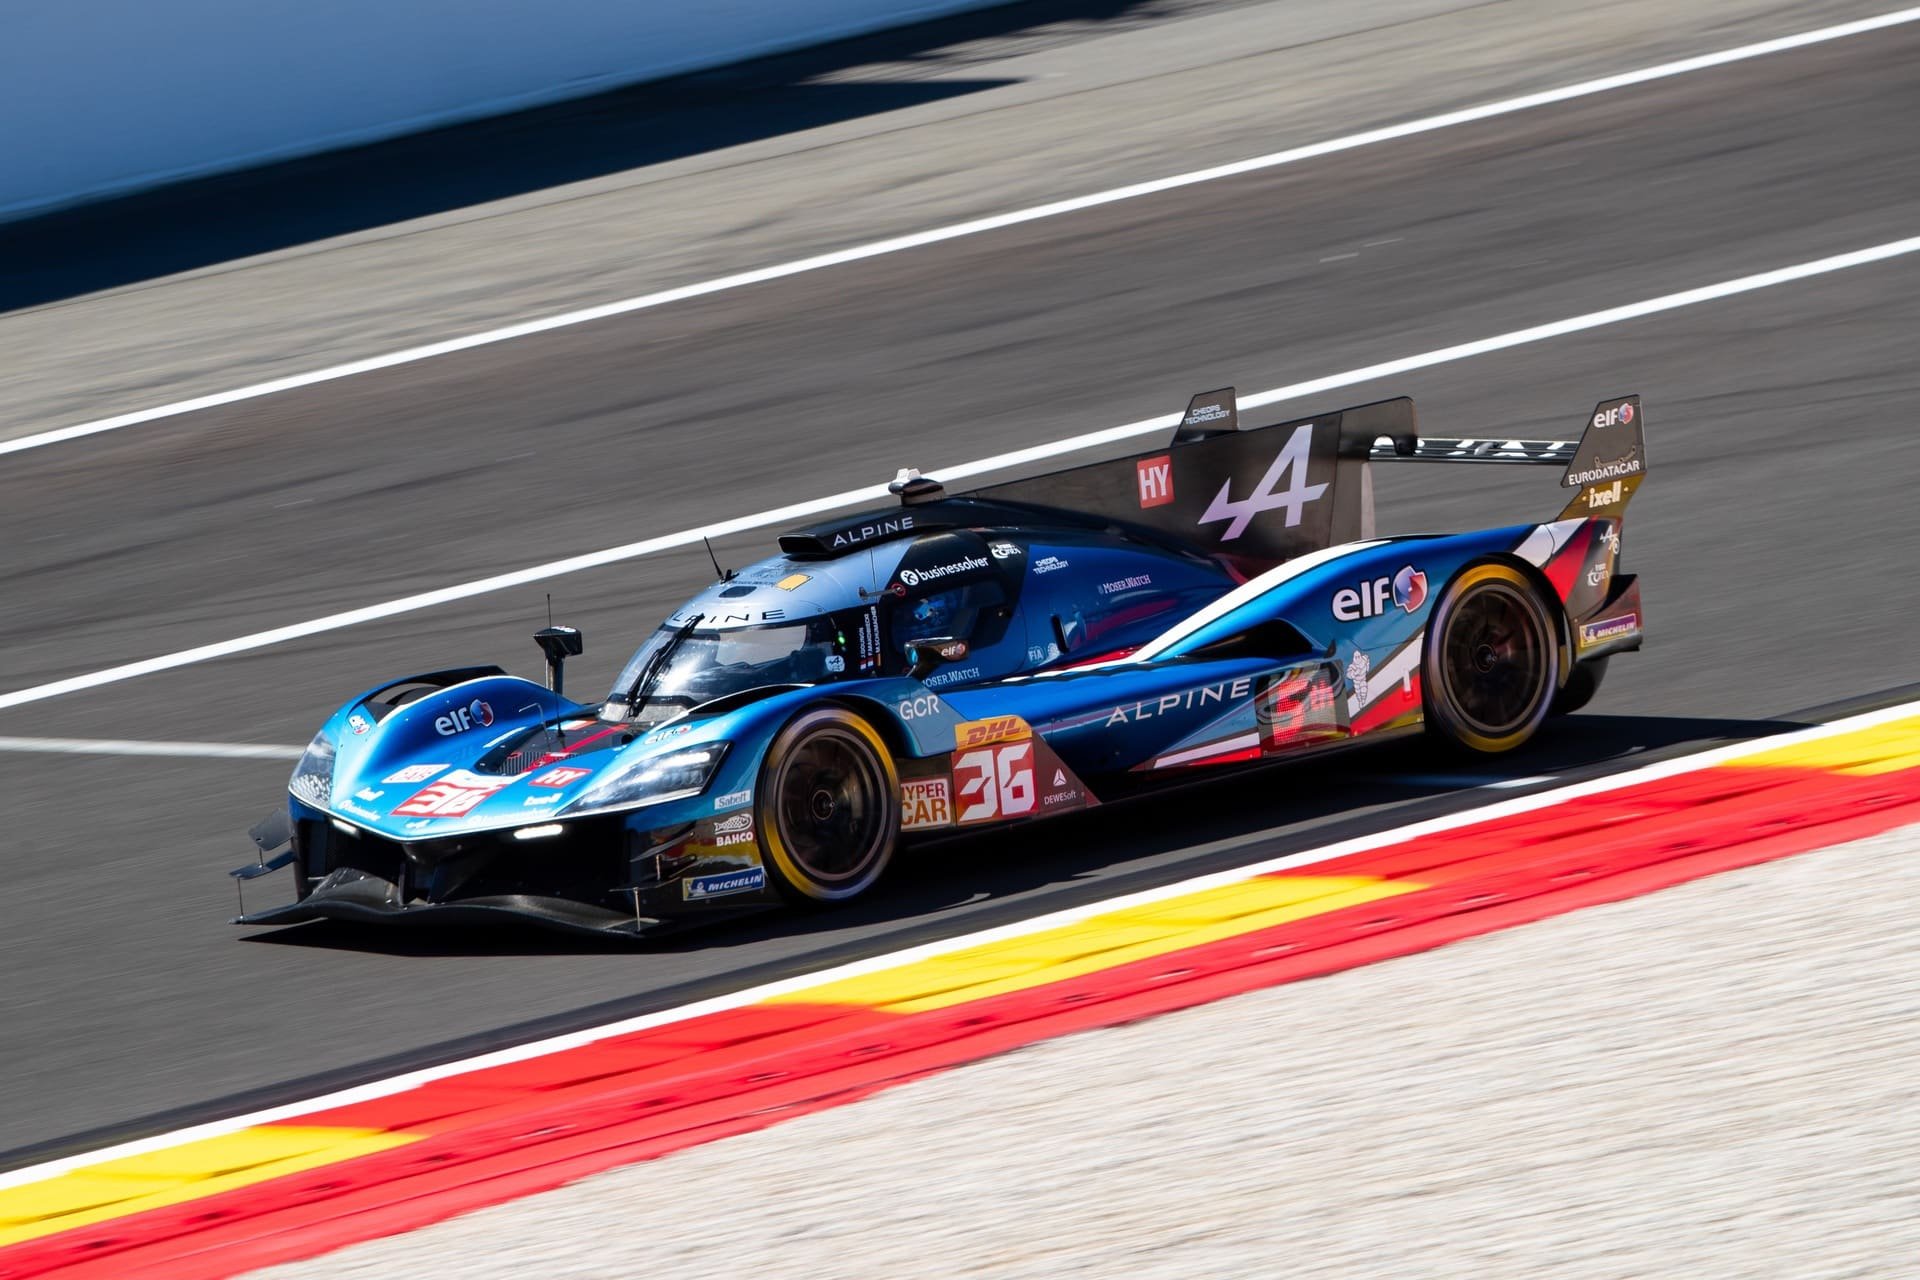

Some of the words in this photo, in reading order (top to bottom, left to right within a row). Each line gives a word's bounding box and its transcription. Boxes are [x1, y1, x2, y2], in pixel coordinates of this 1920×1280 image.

[1185, 409, 1230, 425] TECHNOLOGY
[1192, 404, 1221, 416] CHEOPS
[1593, 408, 1618, 429] elf
[1138, 464, 1169, 501] HY
[1568, 460, 1641, 486] EURODATACAR
[1588, 480, 1622, 509] ixell
[833, 516, 914, 548] ALPINE
[914, 556, 989, 582] businessolver
[1331, 577, 1390, 622] elf
[941, 643, 957, 657] elf
[900, 695, 940, 721] GCR
[1106, 678, 1252, 728] ALPINE
[435, 706, 471, 736] elf
[966, 718, 1022, 745] DHL
[954, 742, 1036, 822] 36
[1044, 790, 1077, 806] DEWESoft
[716, 831, 754, 847] BAHCO
[708, 873, 763, 893] MICHELIN
